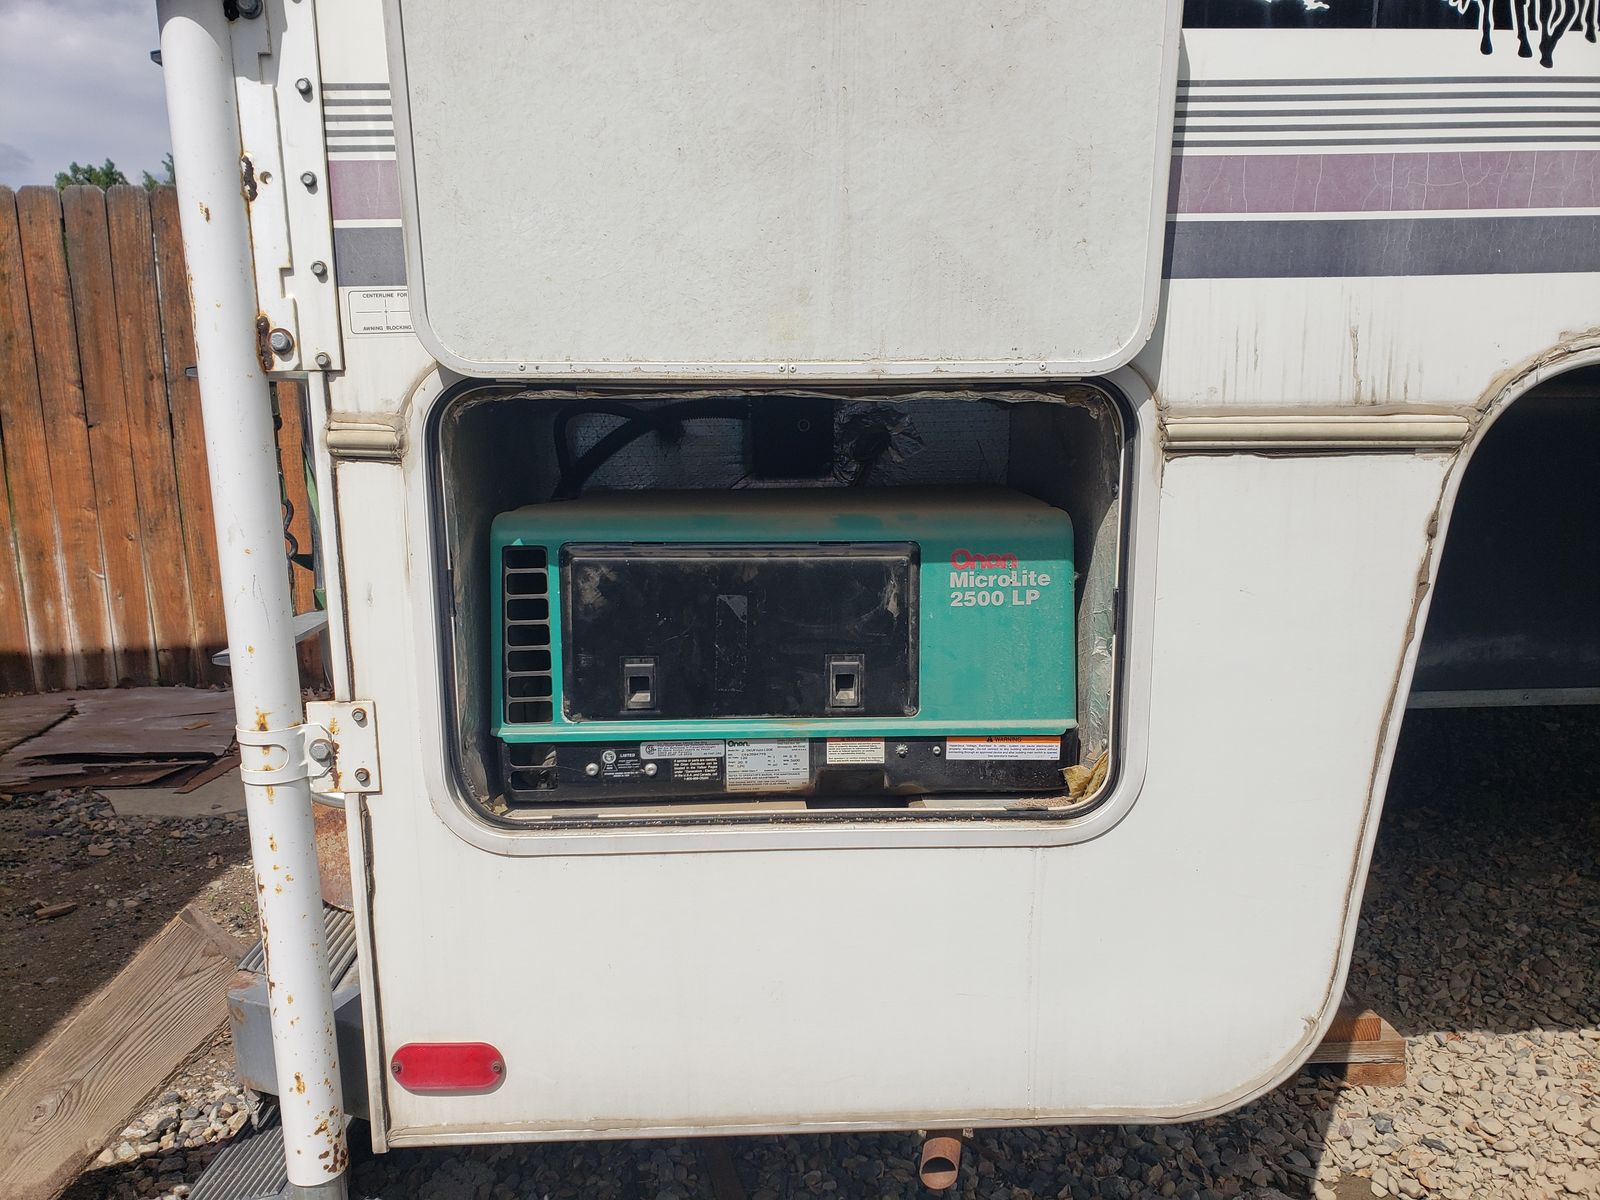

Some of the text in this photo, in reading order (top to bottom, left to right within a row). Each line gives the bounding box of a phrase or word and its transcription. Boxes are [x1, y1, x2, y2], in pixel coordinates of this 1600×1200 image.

[950, 548, 1018, 570] Onan
[950, 570, 1051, 588] MicroLite
[950, 589, 1040, 607] 2500 LP
